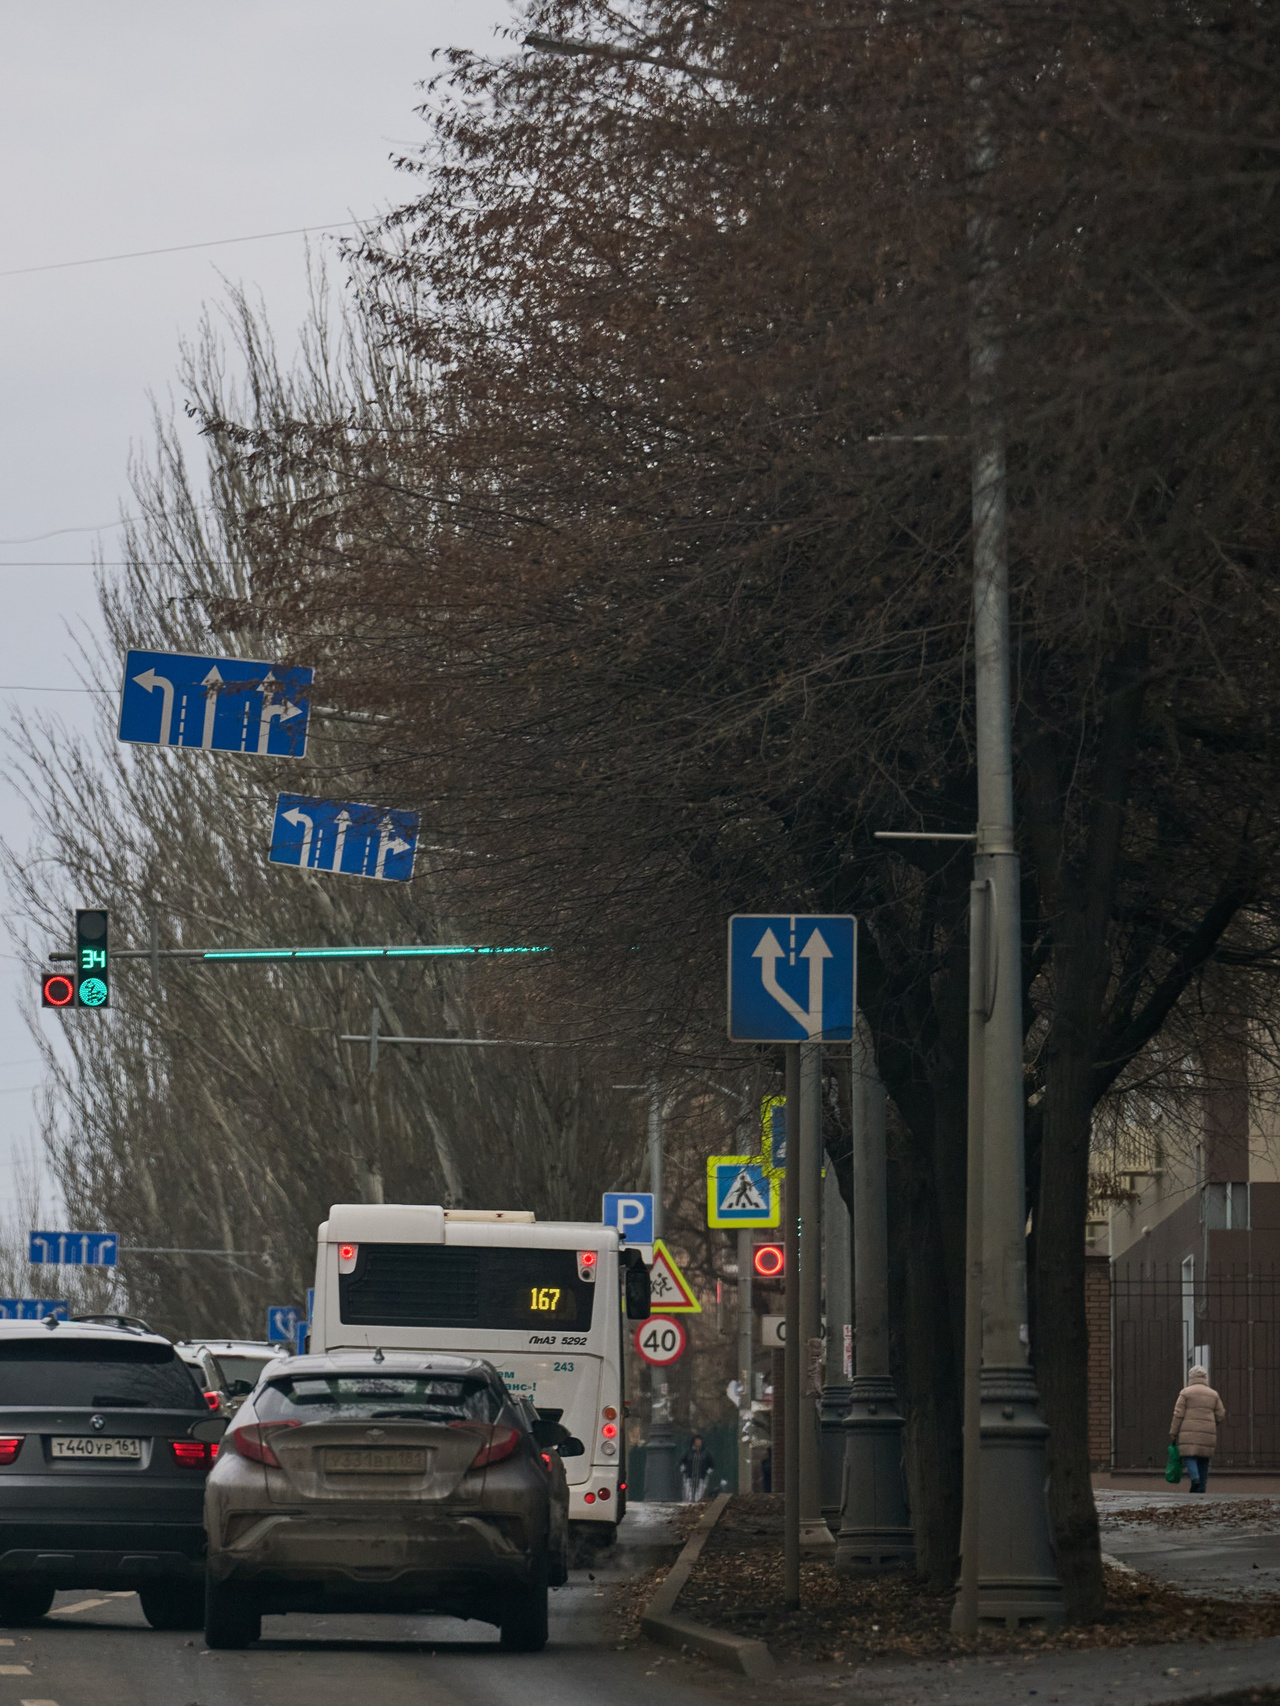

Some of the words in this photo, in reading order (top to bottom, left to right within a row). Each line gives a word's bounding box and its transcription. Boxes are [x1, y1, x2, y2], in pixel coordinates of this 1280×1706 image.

[81, 949, 106, 969] 34
[617, 1199, 644, 1234] P
[530, 1287, 560, 1310] 167
[561, 1336, 588, 1346] 5292
[642, 1328, 676, 1352] 40
[553, 1361, 574, 1372] 243
[497, 1371, 515, 1379] ем
[504, 1382, 537, 1392] анс»!
[115, 1440, 137, 1452] 161
